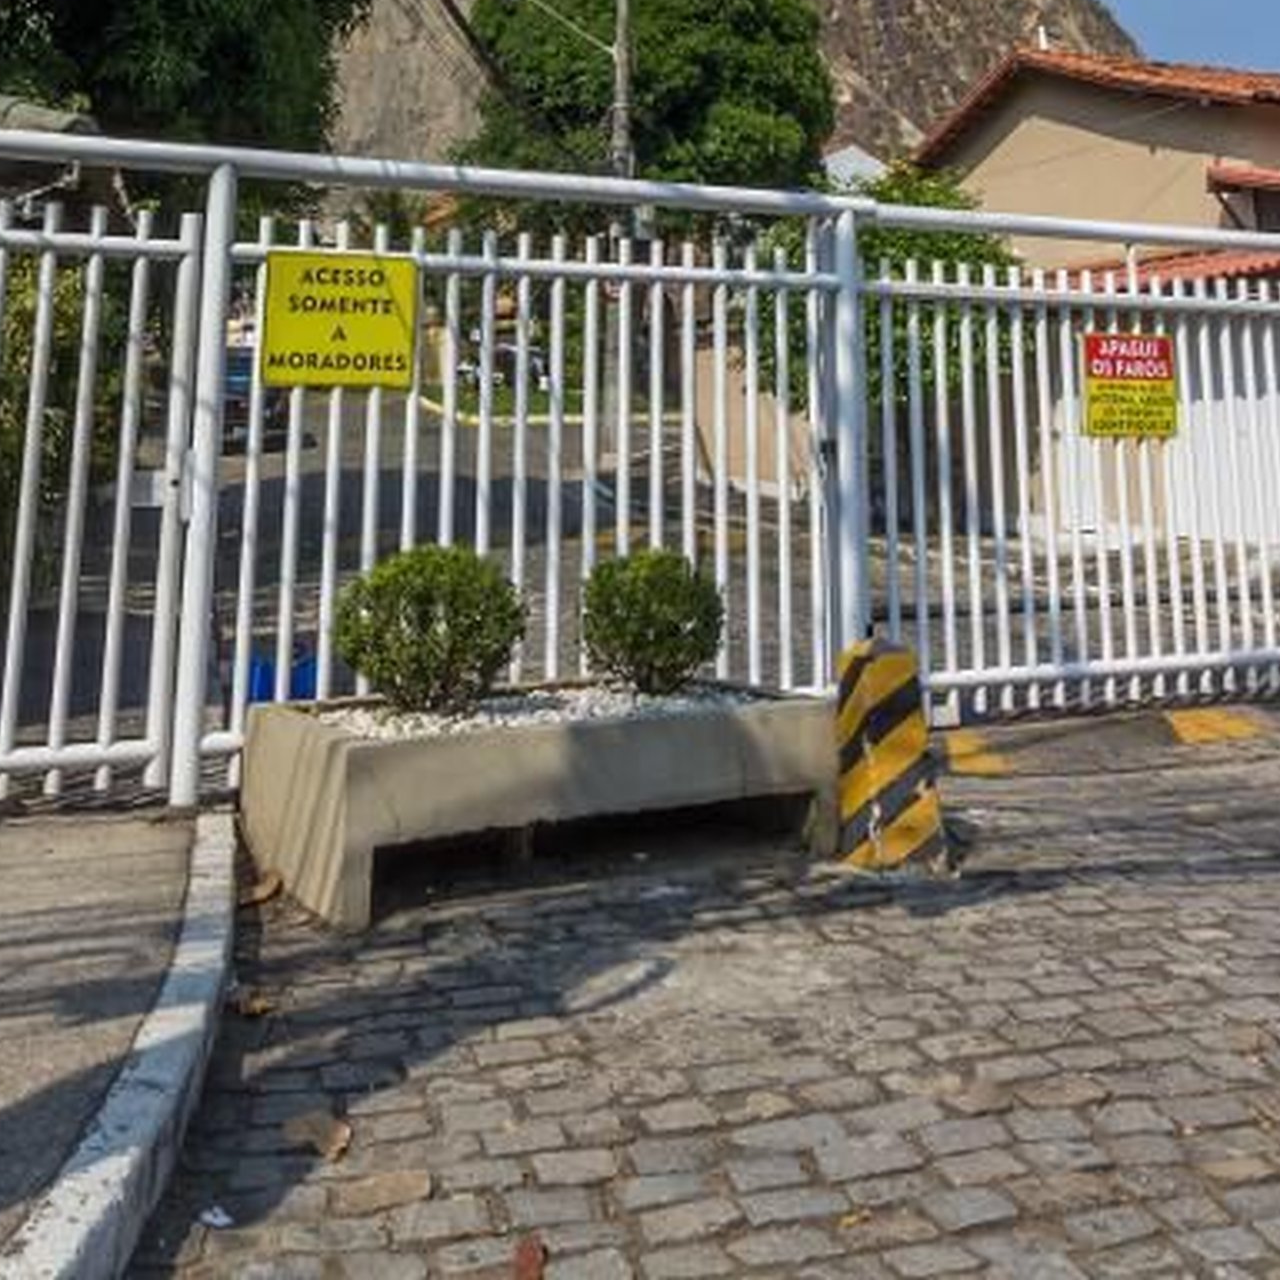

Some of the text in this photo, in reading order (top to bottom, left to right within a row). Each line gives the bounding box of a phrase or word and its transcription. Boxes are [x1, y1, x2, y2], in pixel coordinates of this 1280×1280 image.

[300, 267, 385, 287] ACESSO
[288, 295, 395, 314] SOMENTE
[330, 325, 347, 341] A
[269, 352, 406, 371] MORADORES
